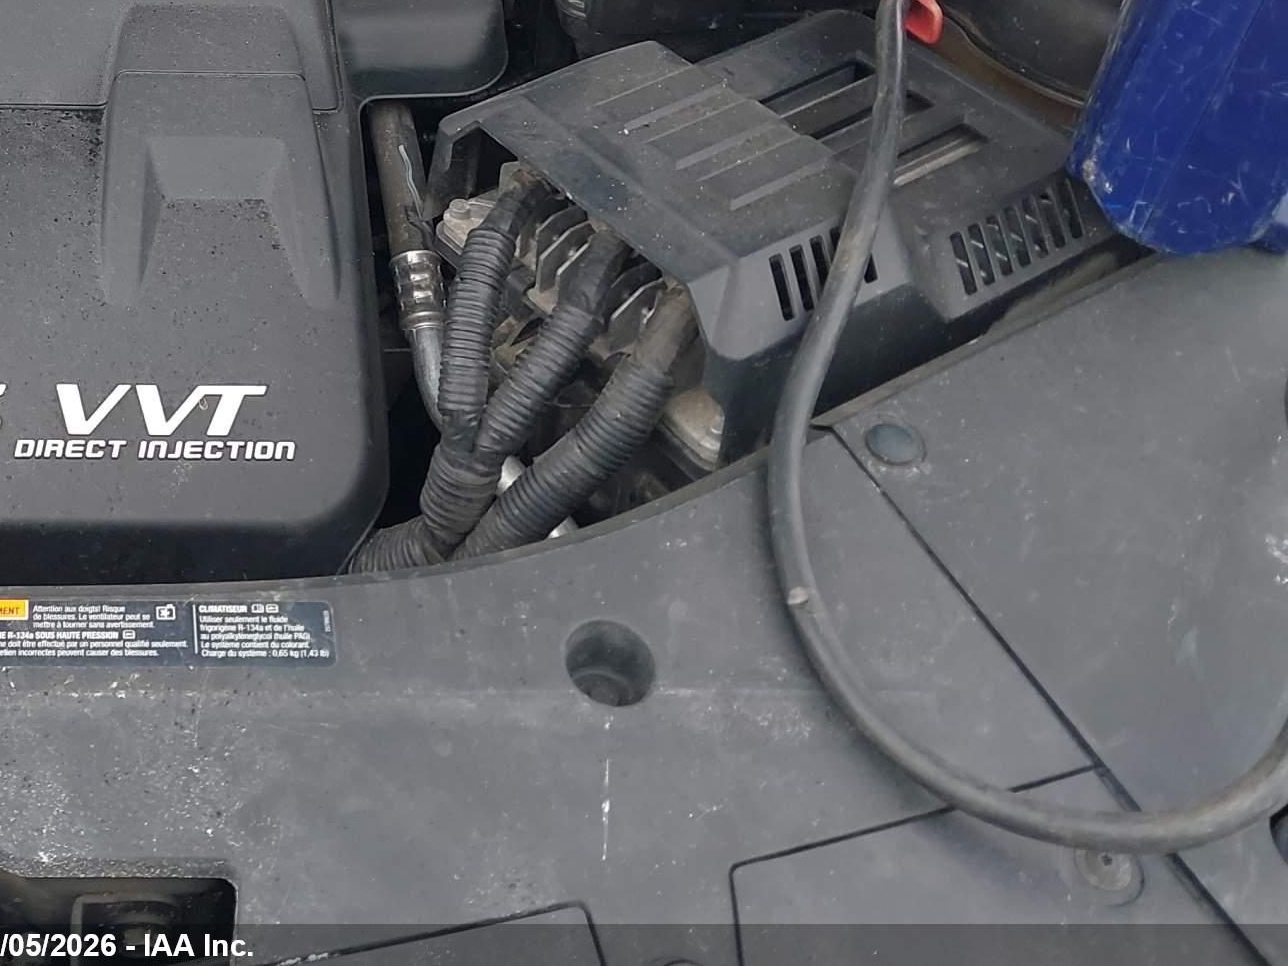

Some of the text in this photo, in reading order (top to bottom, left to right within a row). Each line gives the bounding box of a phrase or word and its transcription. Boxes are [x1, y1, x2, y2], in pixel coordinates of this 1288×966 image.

[56, 383, 267, 436] VVT
[14, 440, 296, 460] DIRECT INJECTION
[33, 605, 63, 613] Attention
[199, 604, 247, 613] CLIMATISEUR
[35, 631, 55, 639] SOUS
[57, 631, 80, 639] HAUTE
[82, 631, 118, 639] PRESSION
